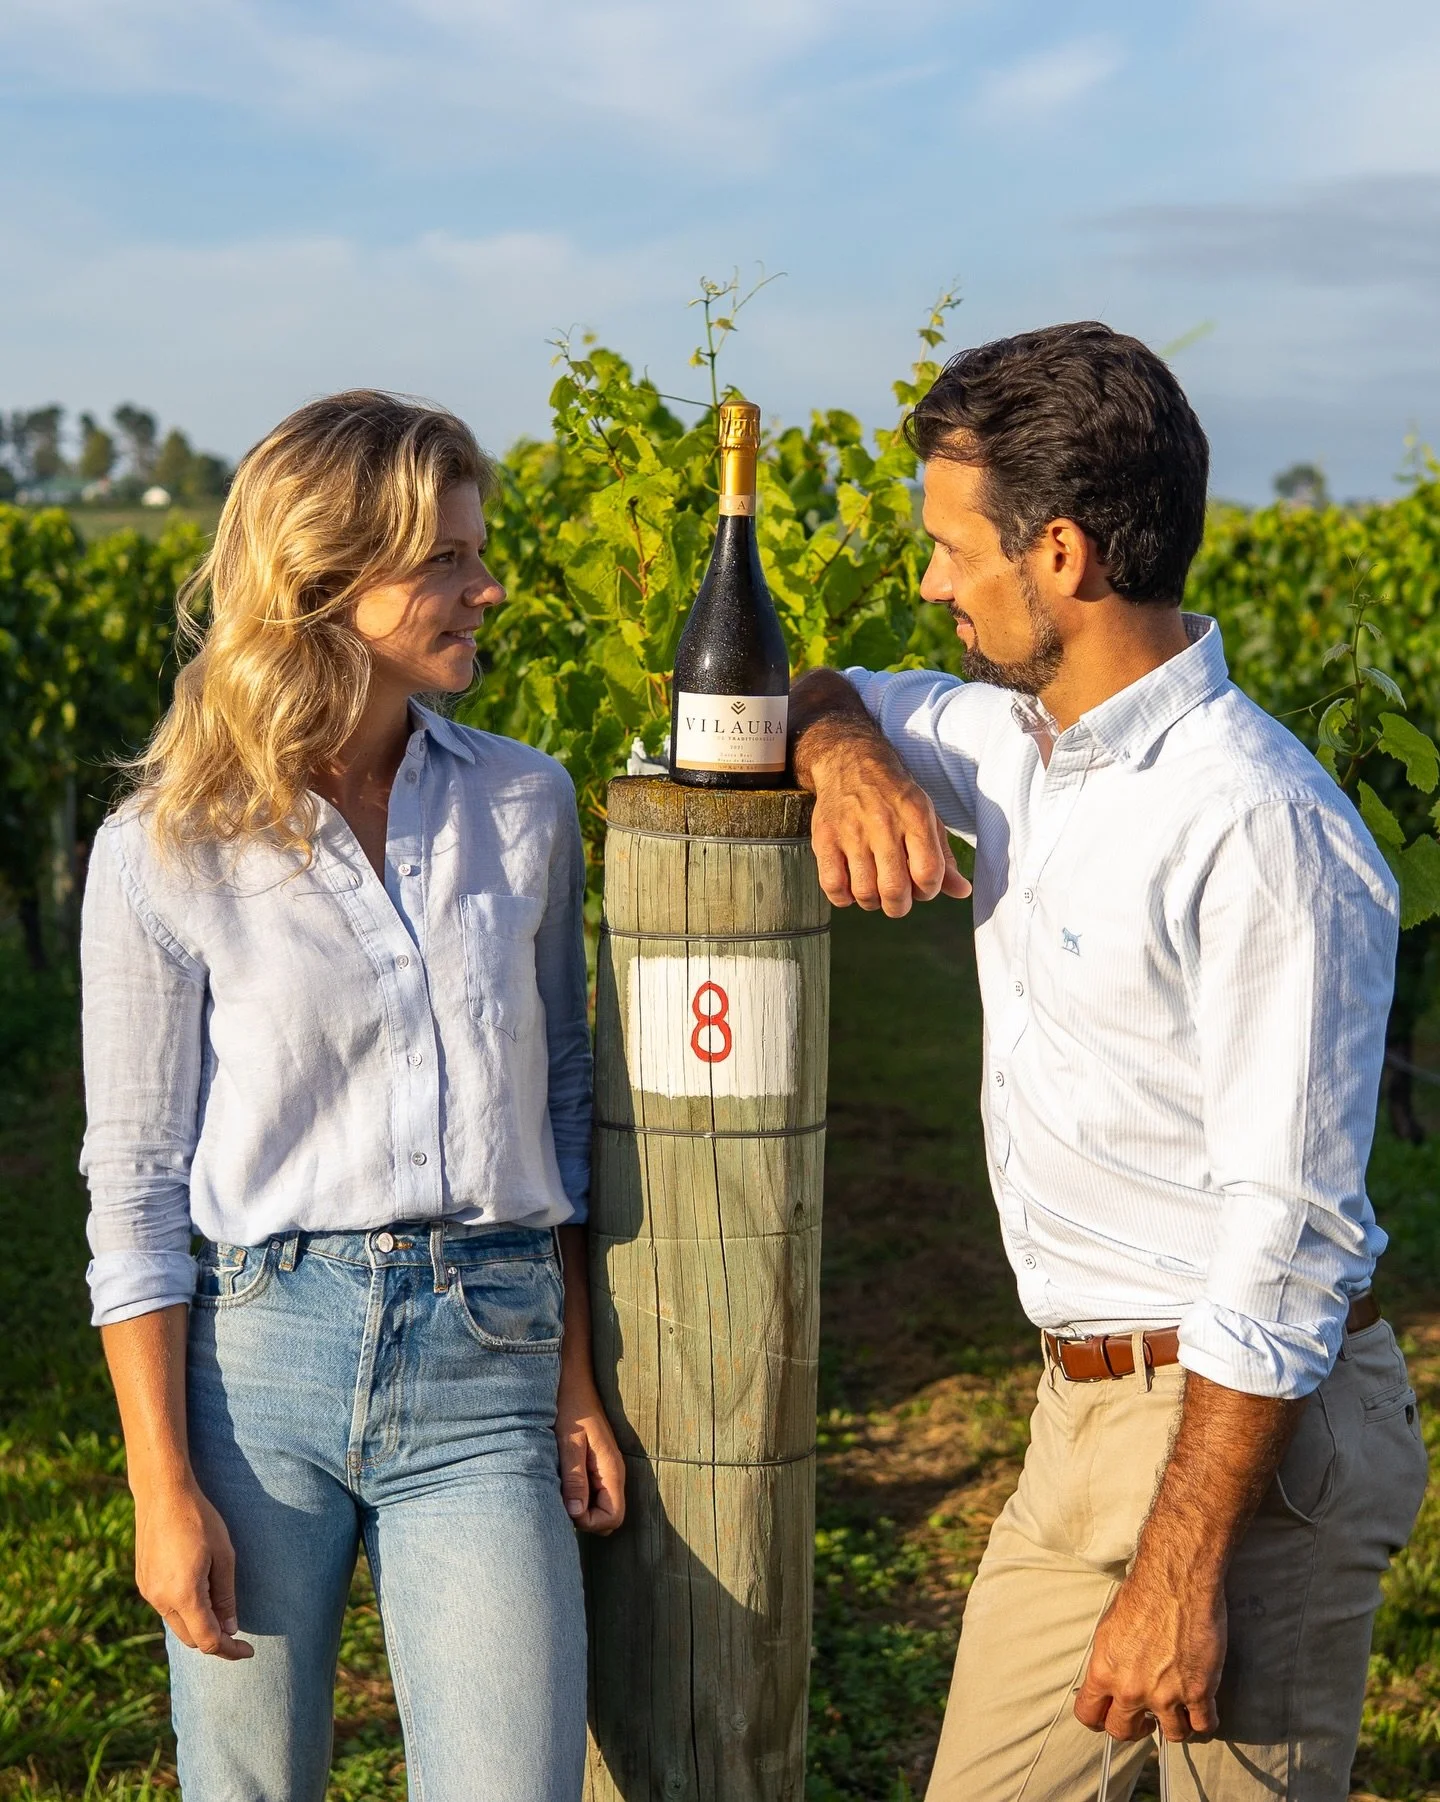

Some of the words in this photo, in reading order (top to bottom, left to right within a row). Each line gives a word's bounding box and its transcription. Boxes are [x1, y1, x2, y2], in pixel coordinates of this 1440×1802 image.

[737, 500, 746, 510] A
[686, 717, 783, 734] VILAURA
[691, 981, 732, 1063] 8
